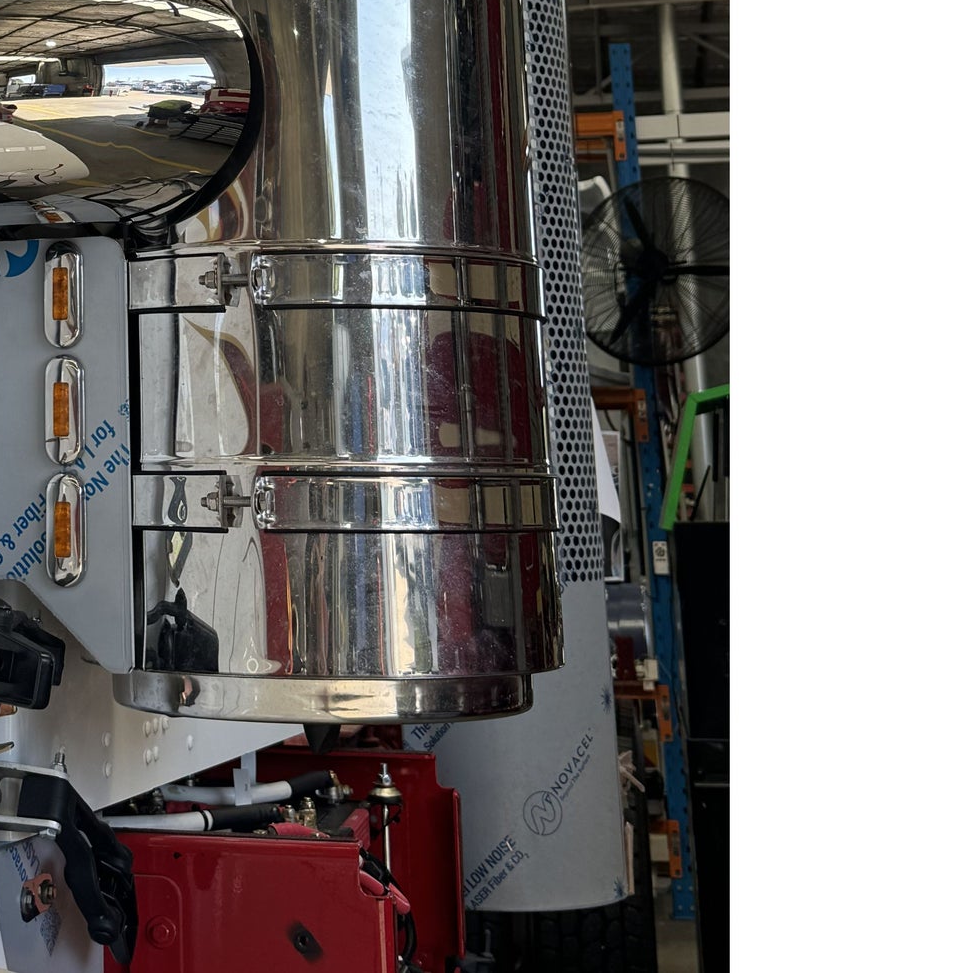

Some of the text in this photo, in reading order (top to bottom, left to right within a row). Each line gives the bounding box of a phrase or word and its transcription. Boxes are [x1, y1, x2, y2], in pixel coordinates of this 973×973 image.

[90, 419, 116, 447] for
[12, 493, 47, 537] Fiber
[411, 723, 431, 740] The
[423, 722, 451, 752] Solution
[465, 835, 516, 888] LOW NOISE
[487, 869, 508, 890] Fiber
[505, 862, 515, 871] &
